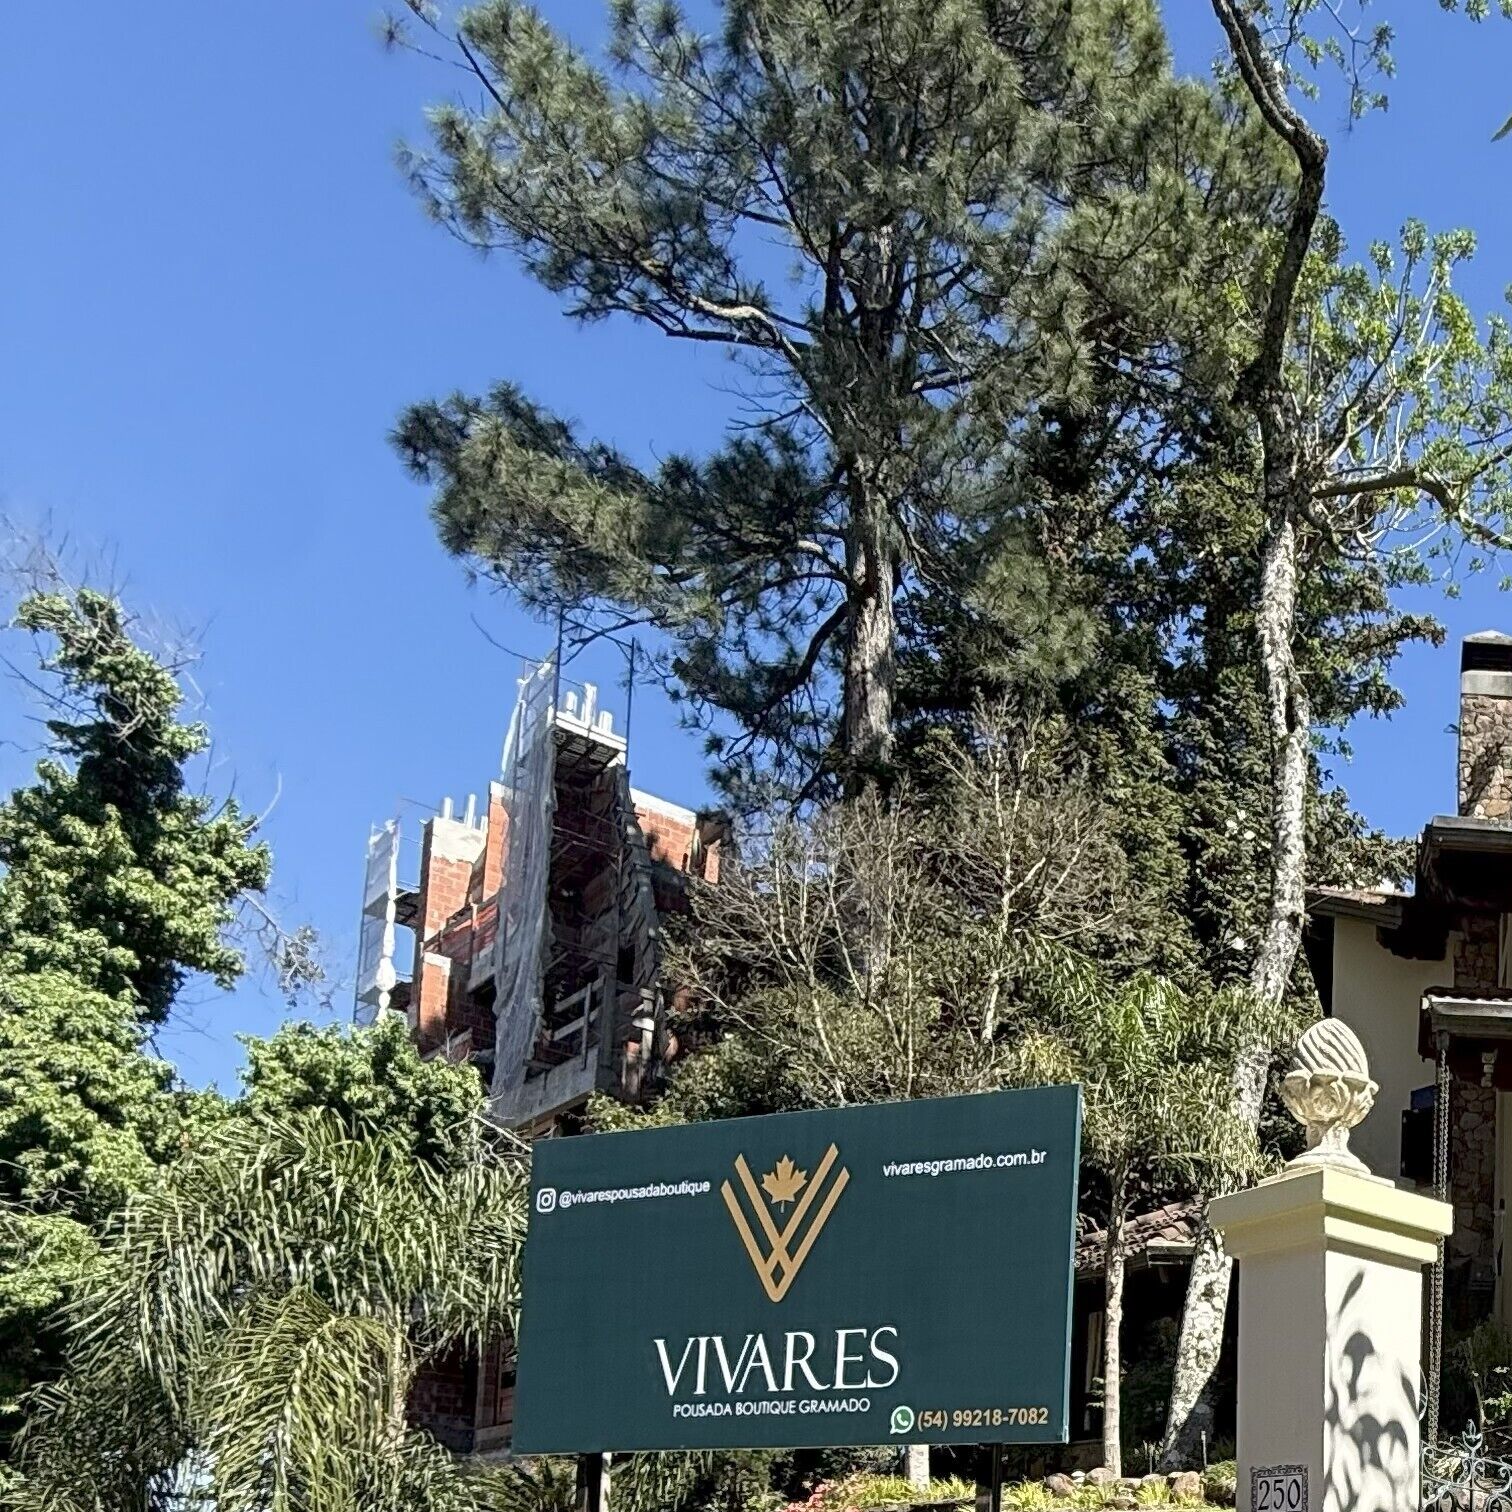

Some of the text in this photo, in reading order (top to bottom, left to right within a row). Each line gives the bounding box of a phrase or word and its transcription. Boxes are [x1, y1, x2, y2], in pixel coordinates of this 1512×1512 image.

[882, 1149, 1047, 1177] vivaresgramado.com.br
[559, 1180, 711, 1208] @vivarespousadaboutique
[653, 1326, 899, 1396] VIVARES
[672, 1397, 871, 1418] POUSADA BOUTIQUE GRAMADO
[917, 1407, 1049, 1432] (54) 99218-7082
[1257, 1478, 1301, 1510] 250
